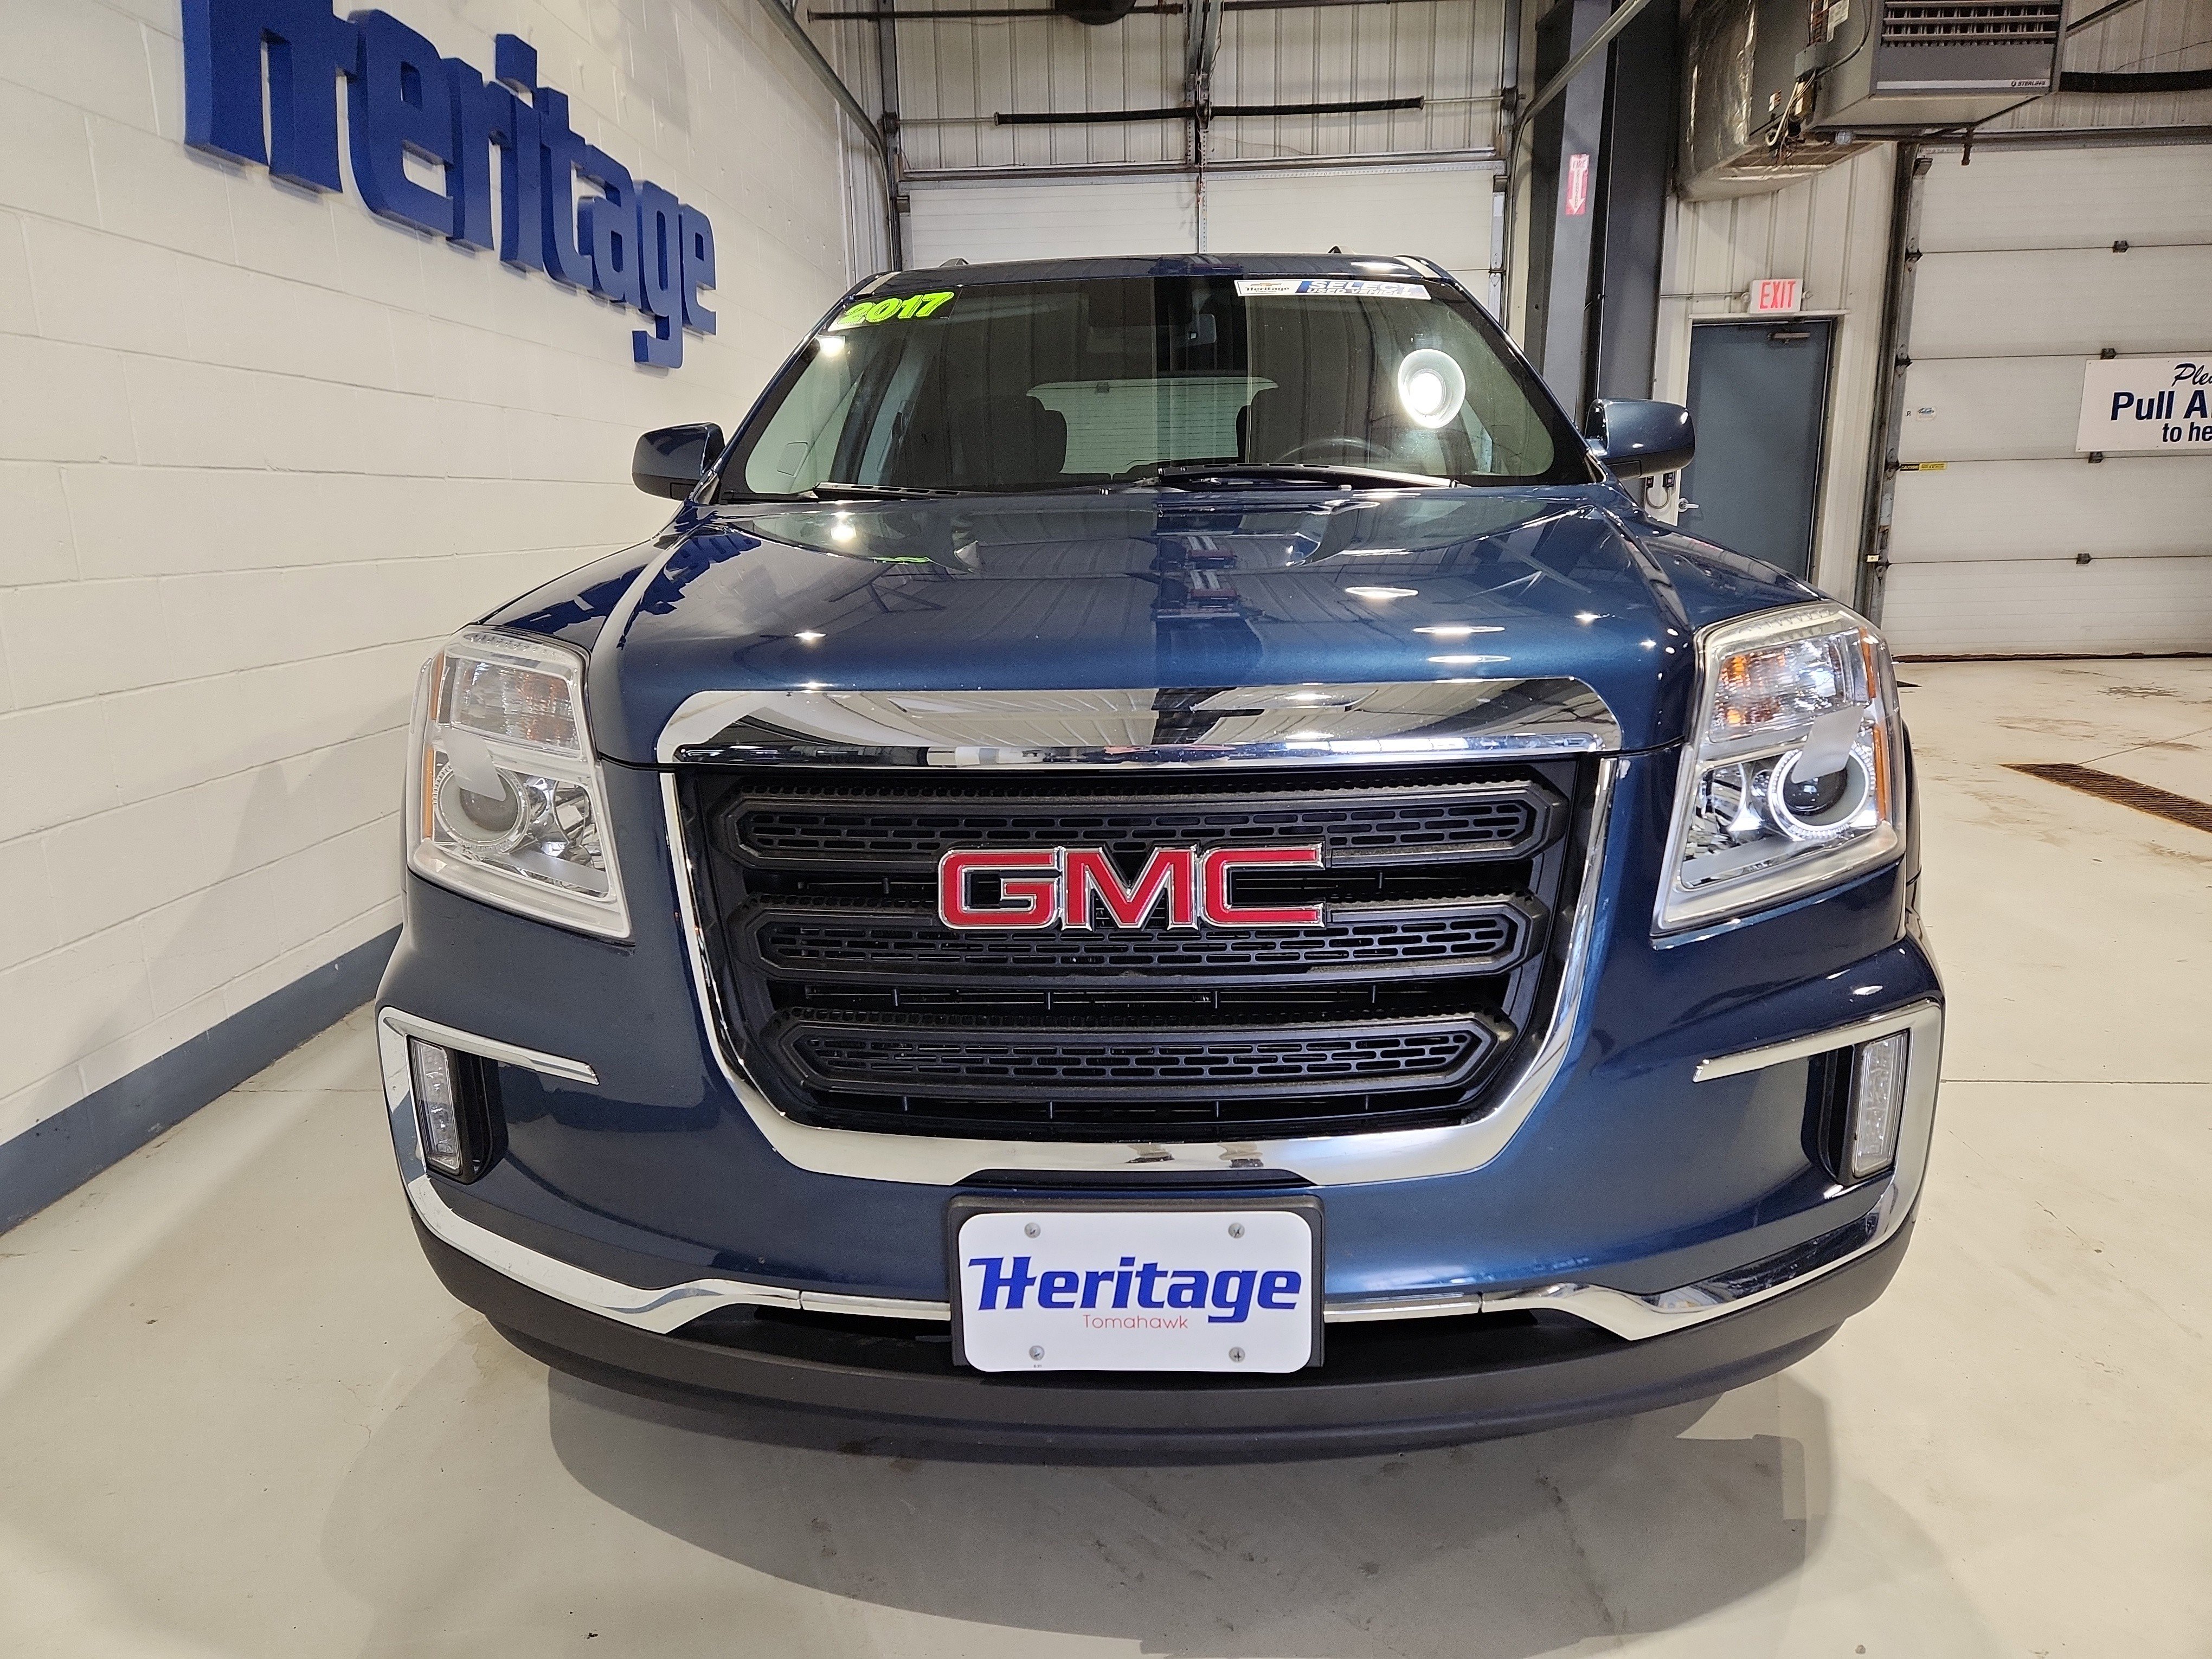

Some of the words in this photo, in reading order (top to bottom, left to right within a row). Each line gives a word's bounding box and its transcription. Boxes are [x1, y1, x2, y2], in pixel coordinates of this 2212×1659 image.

[1573, 159, 1586, 168] FIRE
[1308, 281, 1418, 292] SELECT
[1760, 281, 1796, 309] EXIT
[838, 292, 954, 325] 2017
[2111, 391, 2175, 420] Pull
[2183, 390, 2212, 419] A
[2162, 423, 2182, 442] to
[938, 842, 1326, 930] GMC
[968, 1256, 1302, 1323] Heritage
[1083, 1314, 1188, 1329] Tomahawk
